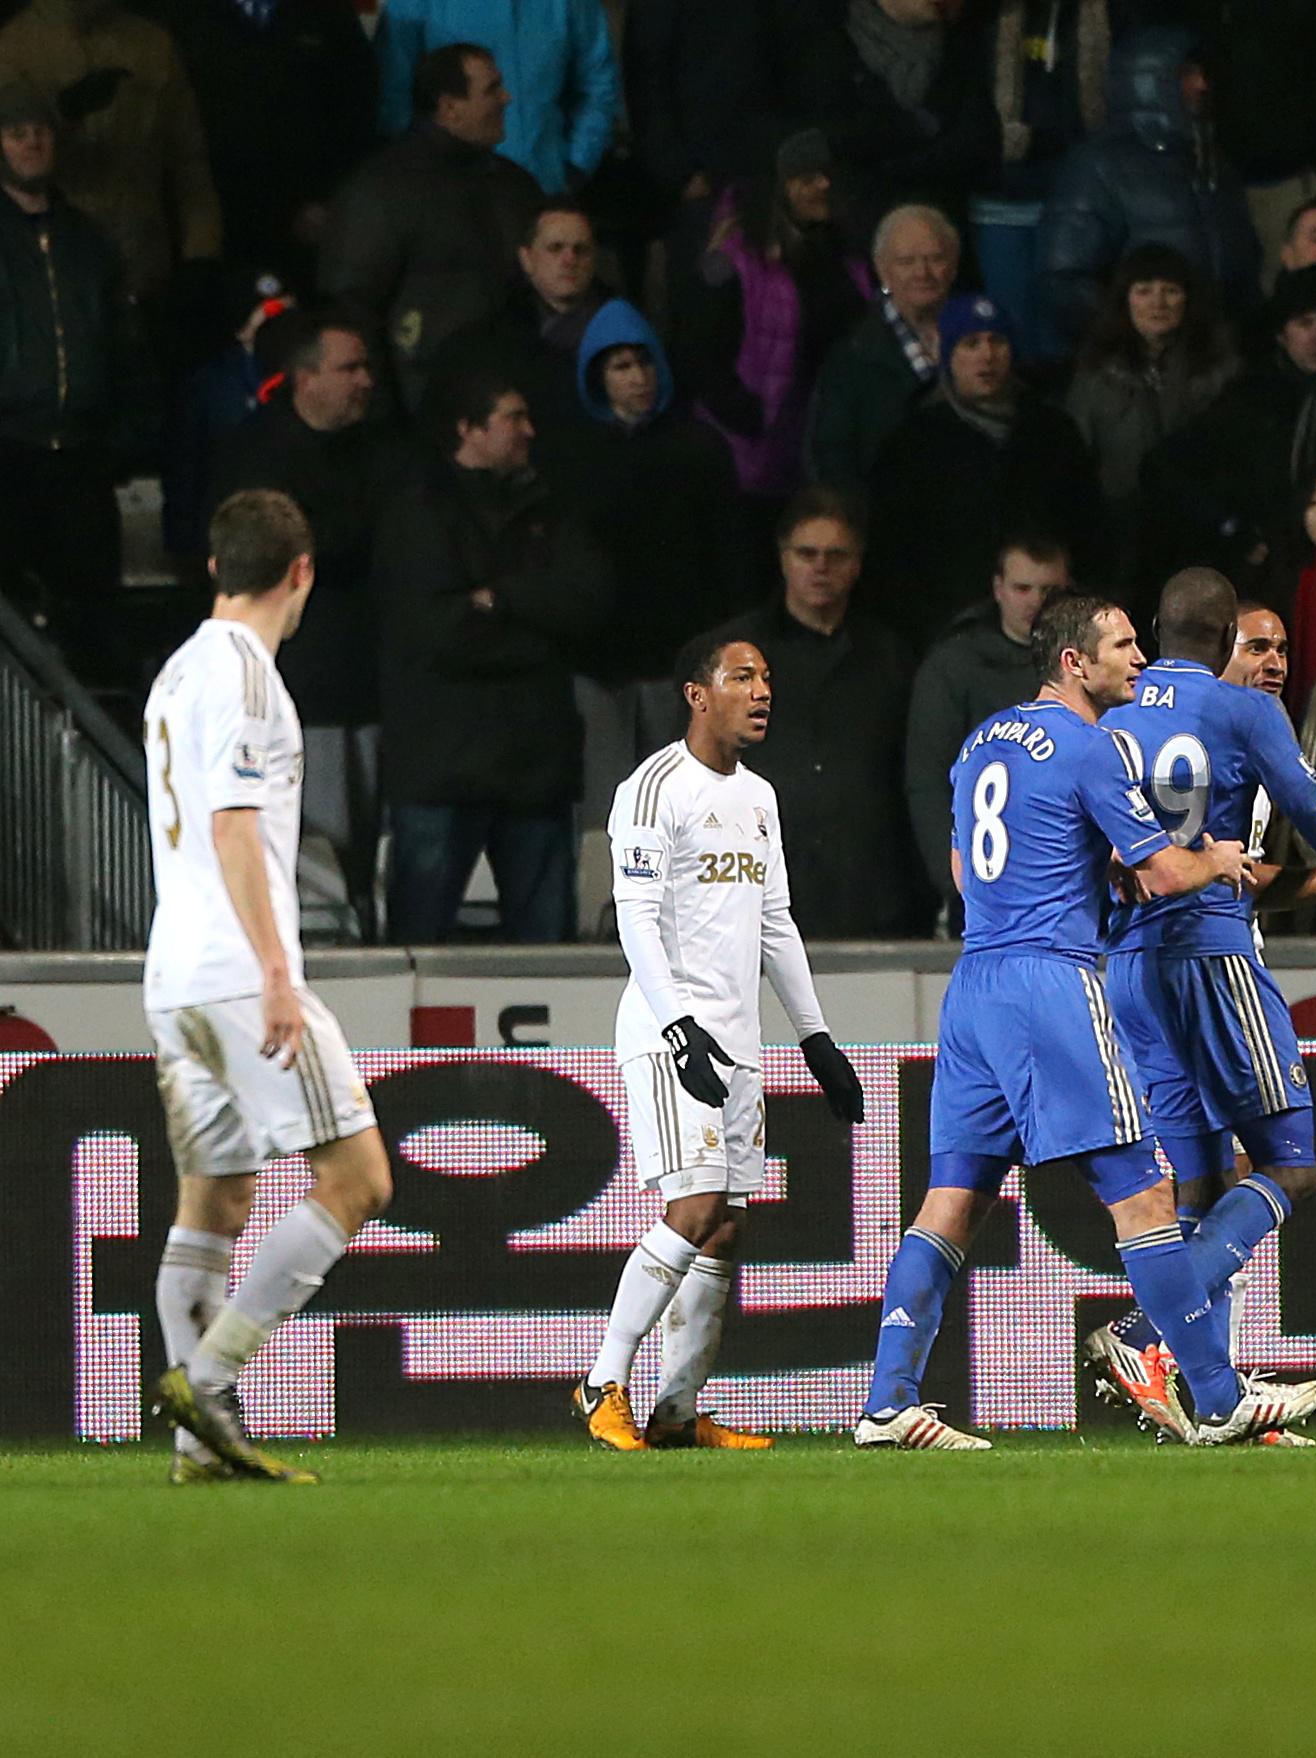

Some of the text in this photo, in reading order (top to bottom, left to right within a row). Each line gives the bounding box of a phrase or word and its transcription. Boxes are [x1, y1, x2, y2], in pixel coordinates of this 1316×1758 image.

[1140, 684, 1175, 708] BA
[971, 761, 1010, 882] 8
[1153, 733, 1212, 847] 9
[697, 852, 767, 887] 32Re
